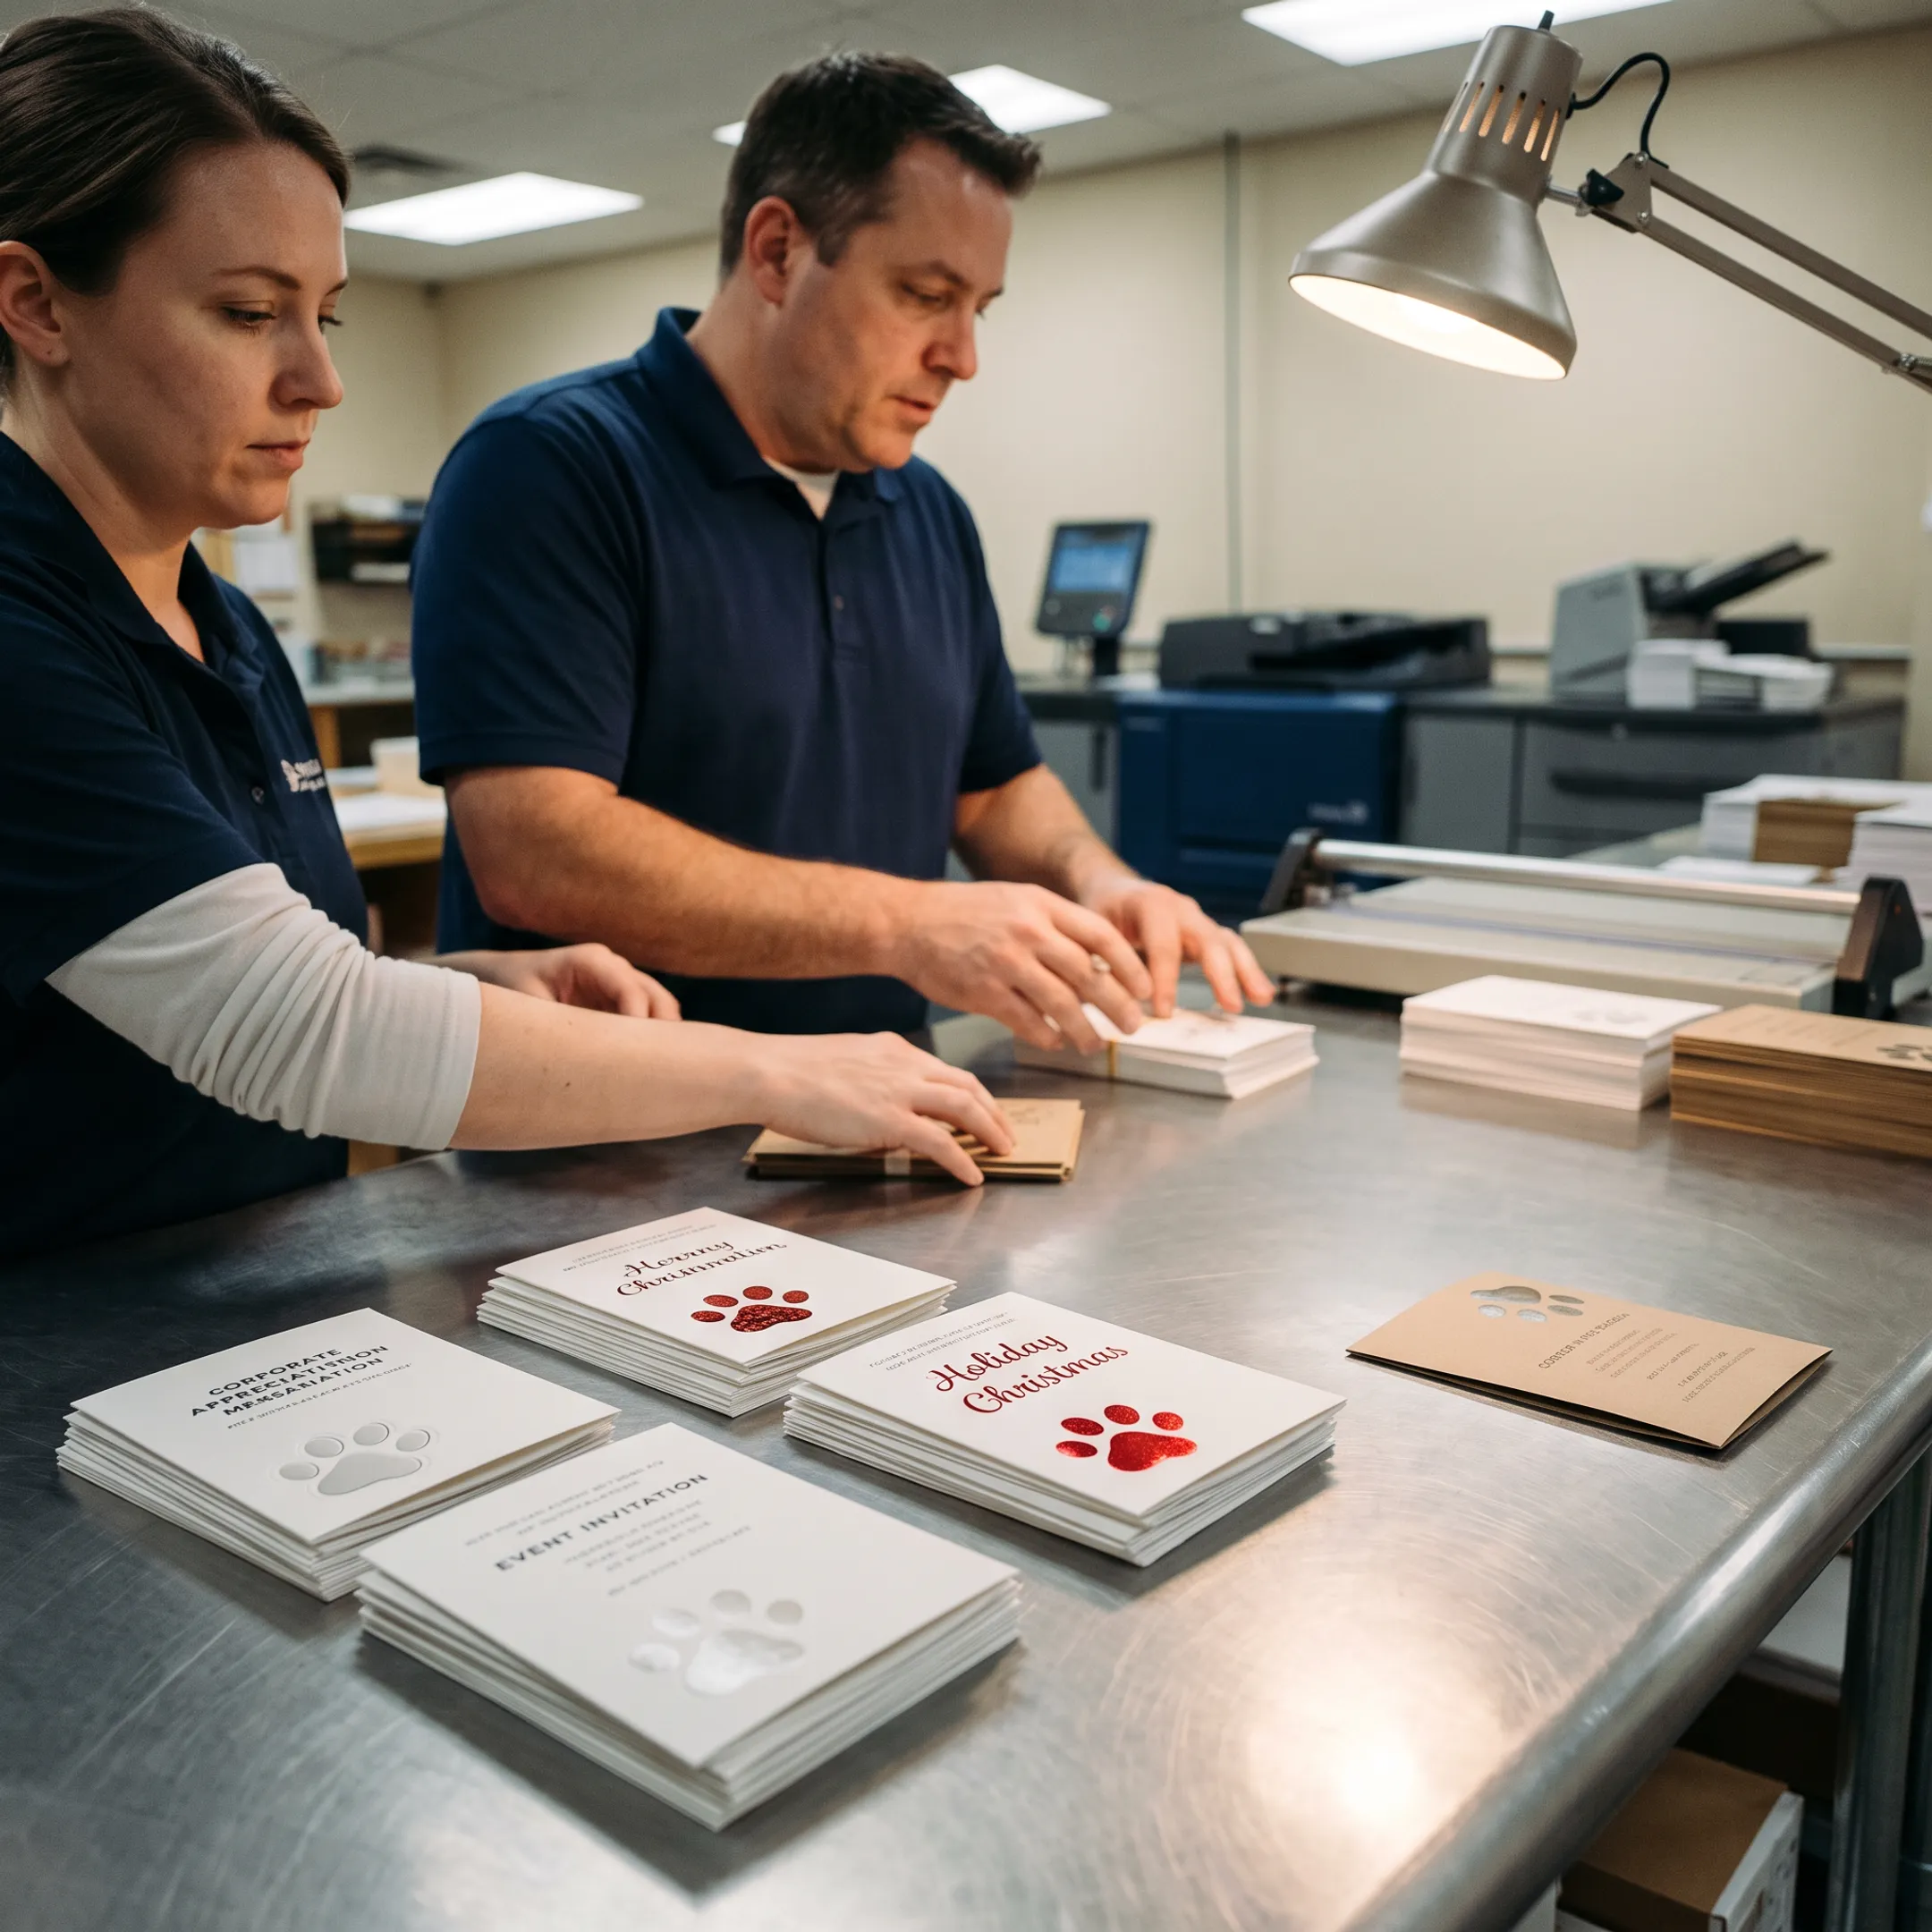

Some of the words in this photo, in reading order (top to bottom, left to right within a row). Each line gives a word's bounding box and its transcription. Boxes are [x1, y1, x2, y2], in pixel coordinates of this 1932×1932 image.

[208, 1349, 343, 1396] CORPORATE
[928, 1335, 1069, 1392] Holiday
[963, 1345, 1129, 1413] Christmas
[495, 1530, 574, 1572] EVENT
[580, 1473, 709, 1533] INVITATION
